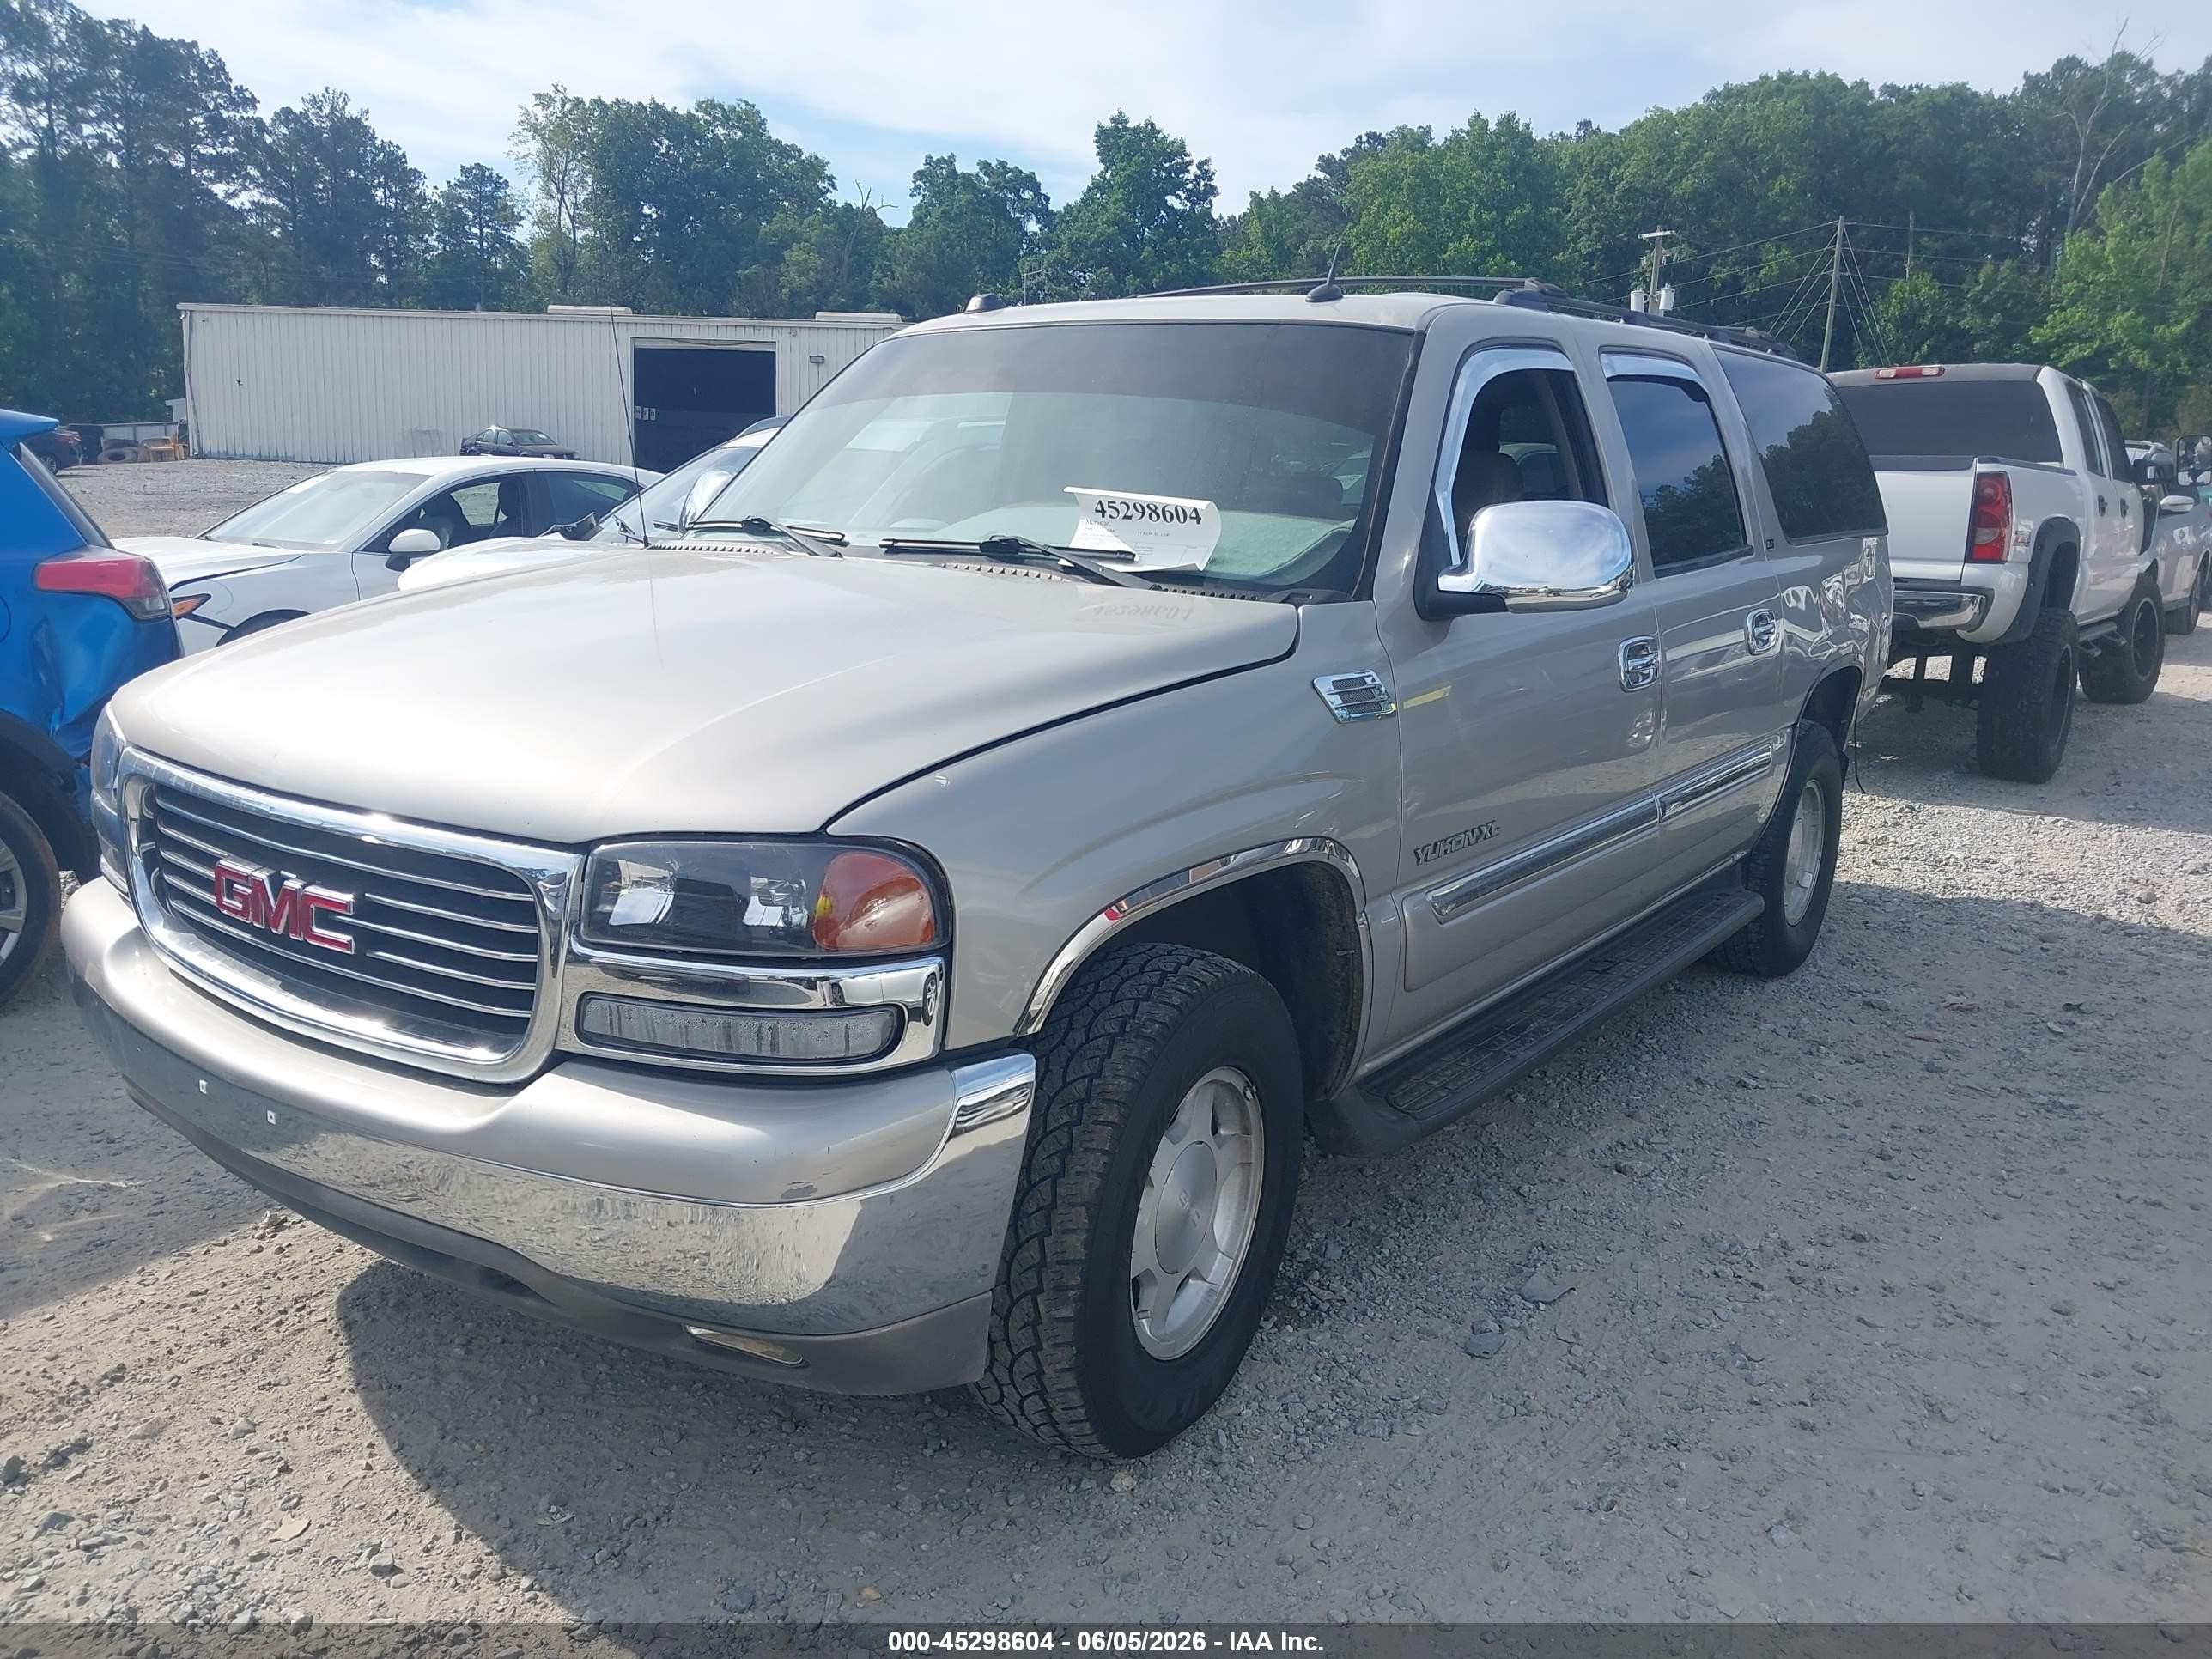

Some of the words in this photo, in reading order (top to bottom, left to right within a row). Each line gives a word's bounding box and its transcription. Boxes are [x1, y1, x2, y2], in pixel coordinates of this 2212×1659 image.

[1095, 500, 1201, 525] 45298604
[1413, 827, 1479, 866] YUKON
[215, 859, 356, 955] GMC
